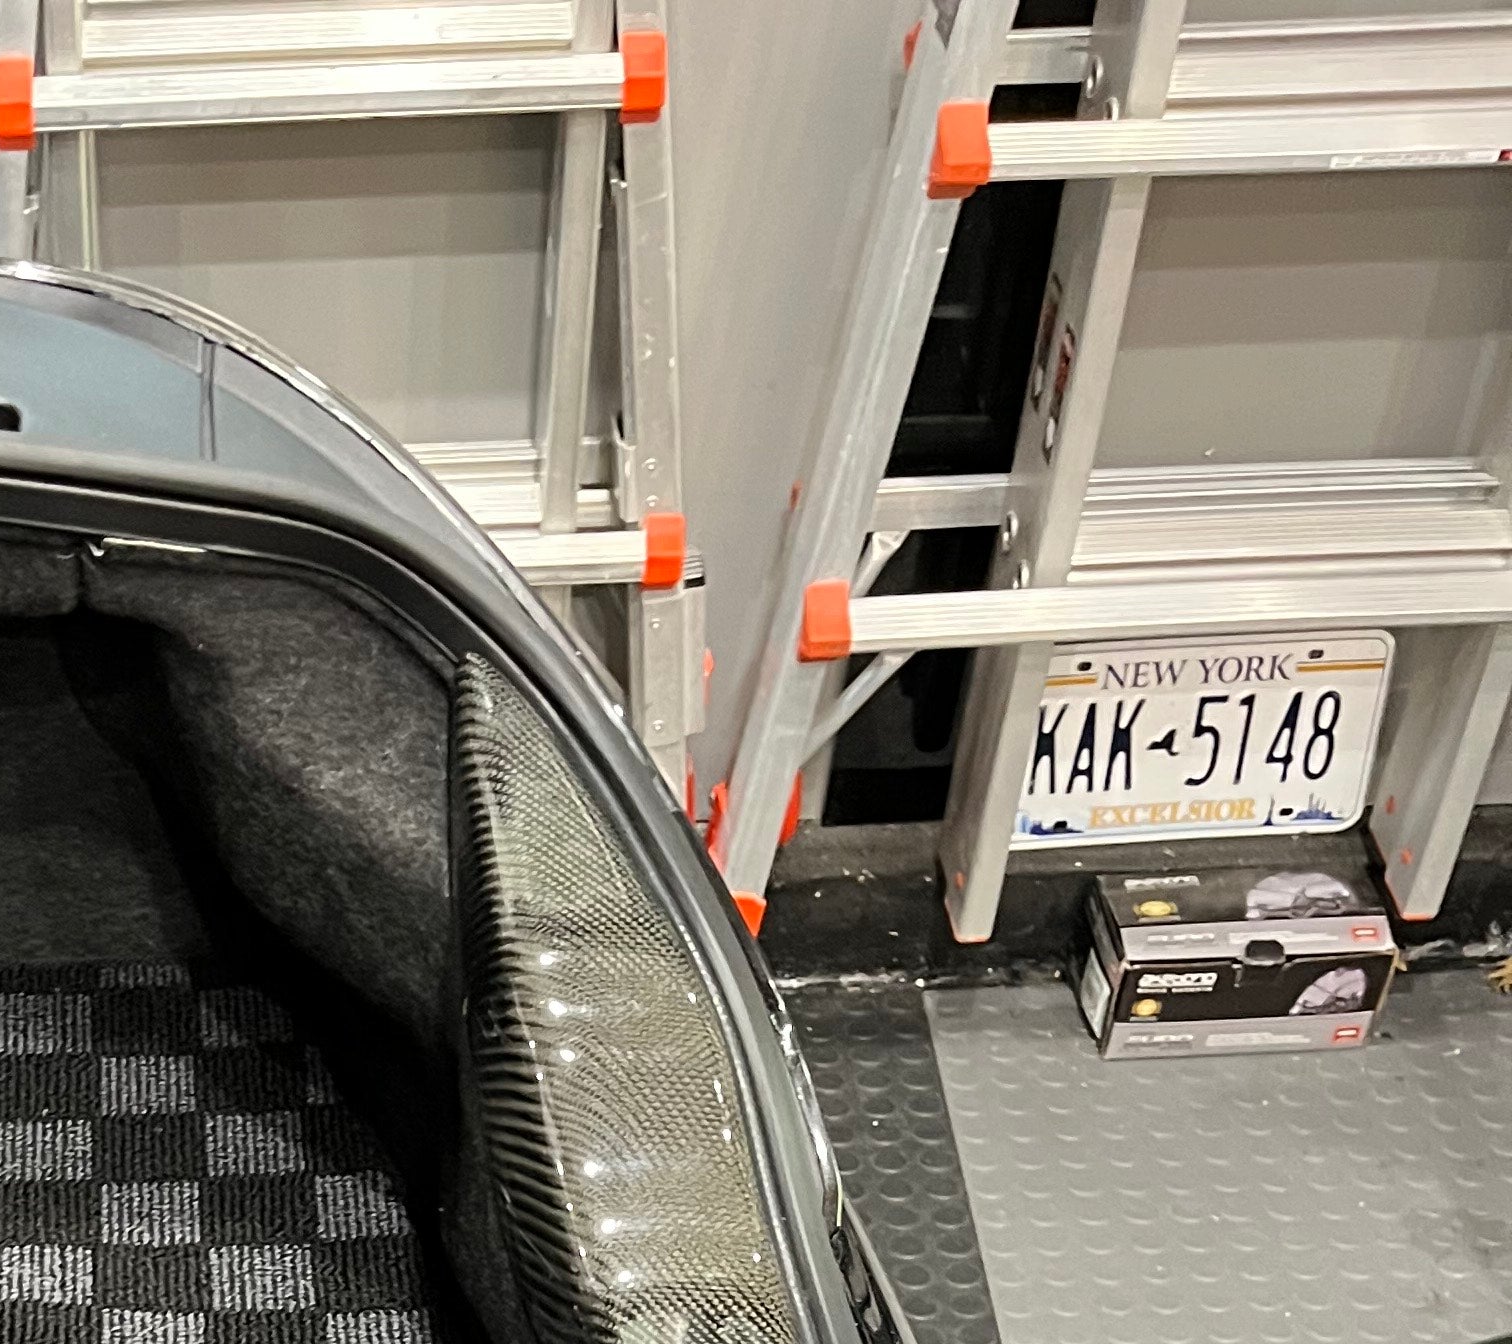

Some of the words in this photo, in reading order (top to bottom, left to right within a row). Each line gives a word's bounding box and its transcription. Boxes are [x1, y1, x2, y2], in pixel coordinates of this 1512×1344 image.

[1100, 659, 1188, 690] NEW
[1198, 653, 1294, 684] YORK
[1028, 698, 1147, 795] KAK
[1184, 690, 1341, 786] 5148
[1090, 797, 1257, 829] EXCELSIOR
